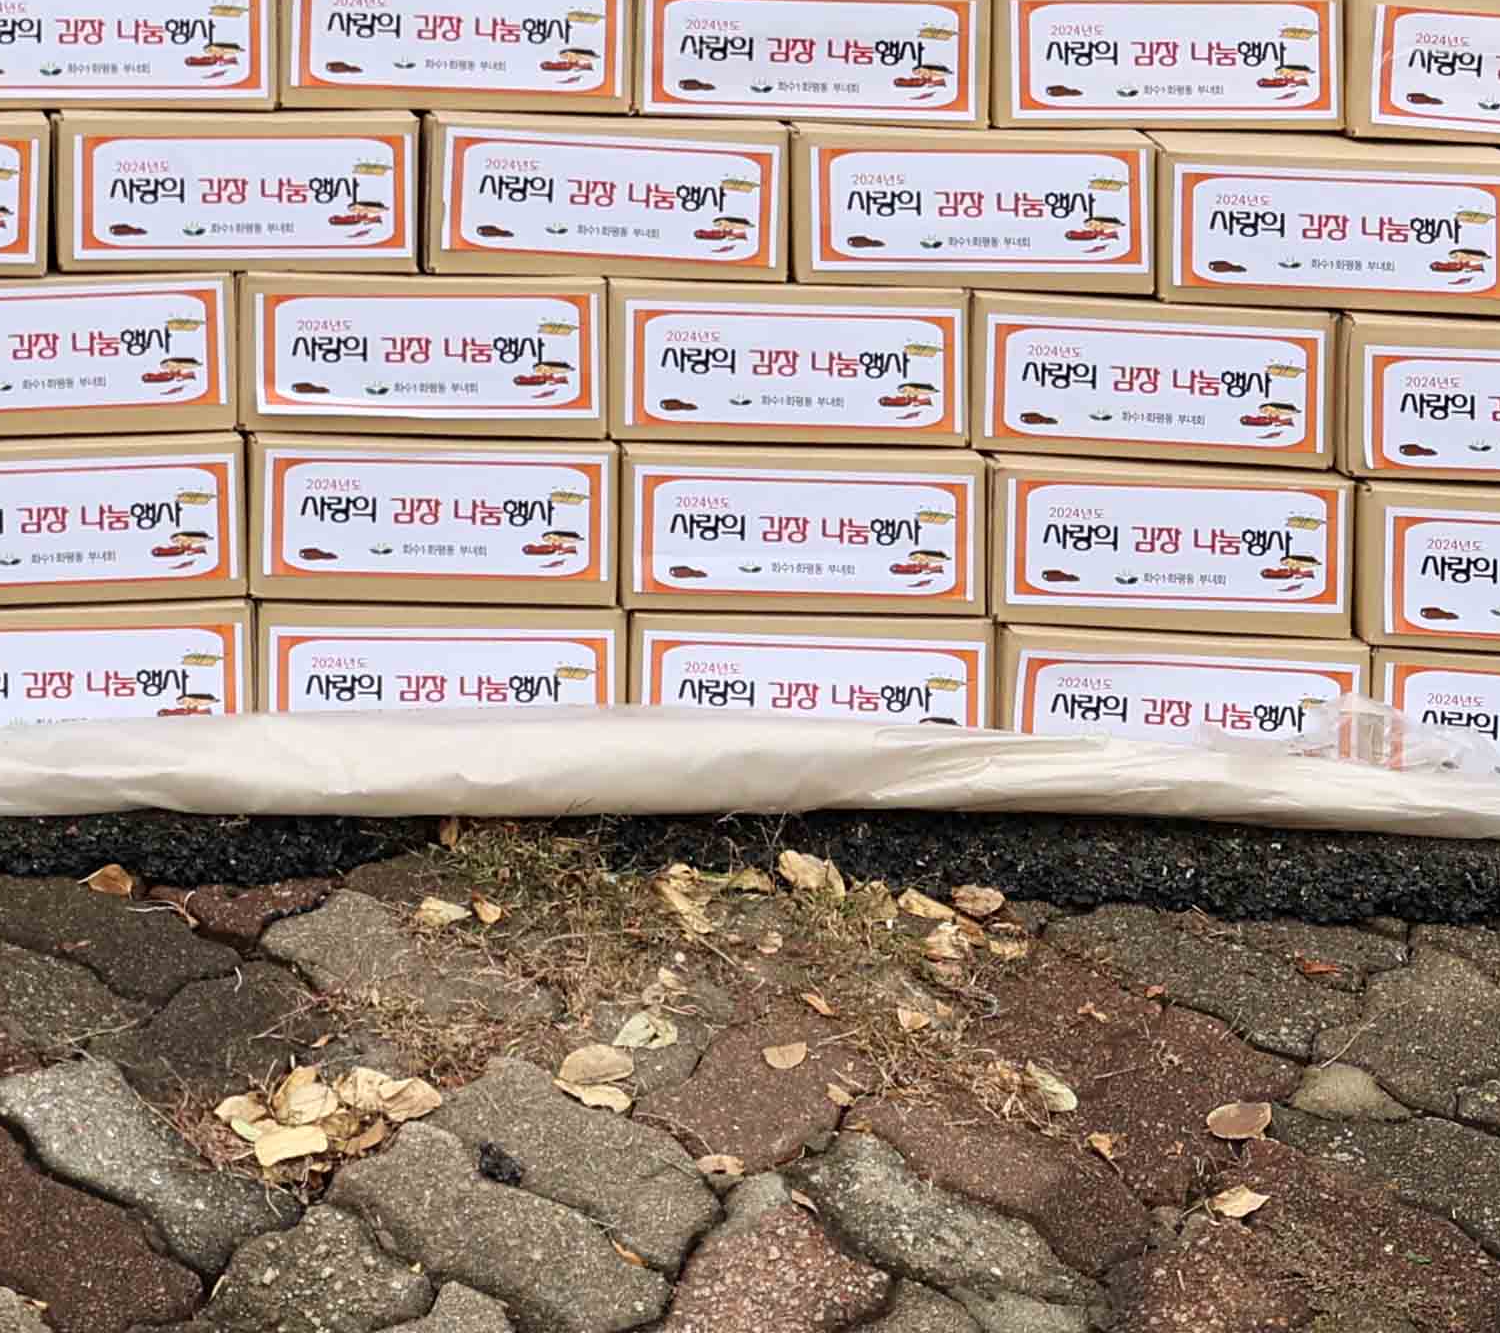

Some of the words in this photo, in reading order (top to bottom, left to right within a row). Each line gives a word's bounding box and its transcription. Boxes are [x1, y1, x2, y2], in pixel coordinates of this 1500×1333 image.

[54, 20, 107, 45] 김장
[679, 35, 755, 63] 사랑의
[766, 37, 818, 65] 김장
[1407, 49, 1484, 80] 사랑의
[109, 177, 186, 206] 사랑의
[198, 177, 250, 206] 김장
[478, 174, 555, 205] 사랑의
[566, 179, 618, 208] 김장
[300, 495, 378, 525] 사랑의
[390, 497, 443, 526] 김장
[1420, 555, 1499, 586] 사랑의
